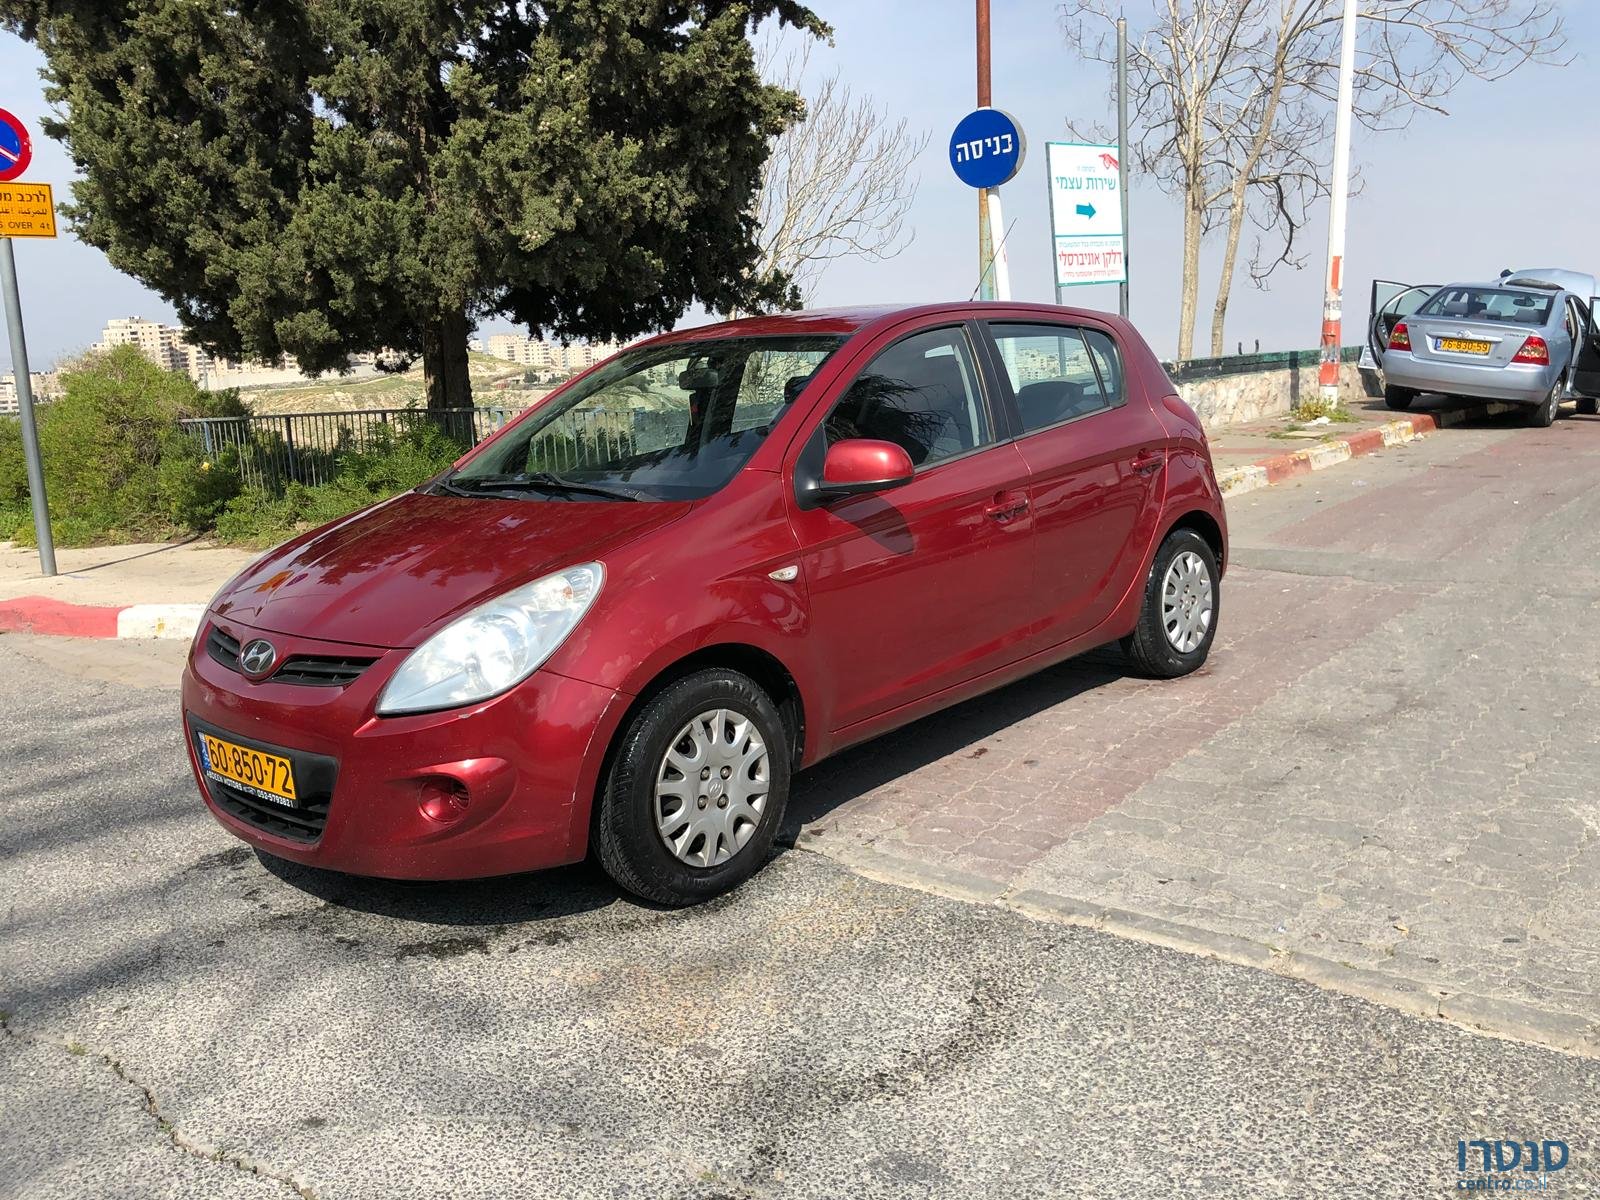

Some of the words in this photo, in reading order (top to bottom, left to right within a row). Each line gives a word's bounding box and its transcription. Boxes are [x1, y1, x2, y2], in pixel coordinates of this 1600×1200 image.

[955, 133, 1013, 163] כניסה
[1055, 175, 1083, 190] עצמי
[1085, 175, 1116, 191] שירות
[16, 190, 46, 203] לרכב
[8, 221, 33, 229] OVER
[1058, 249, 1101, 267] אוניברסלי
[1102, 248, 1122, 268] דלקן
